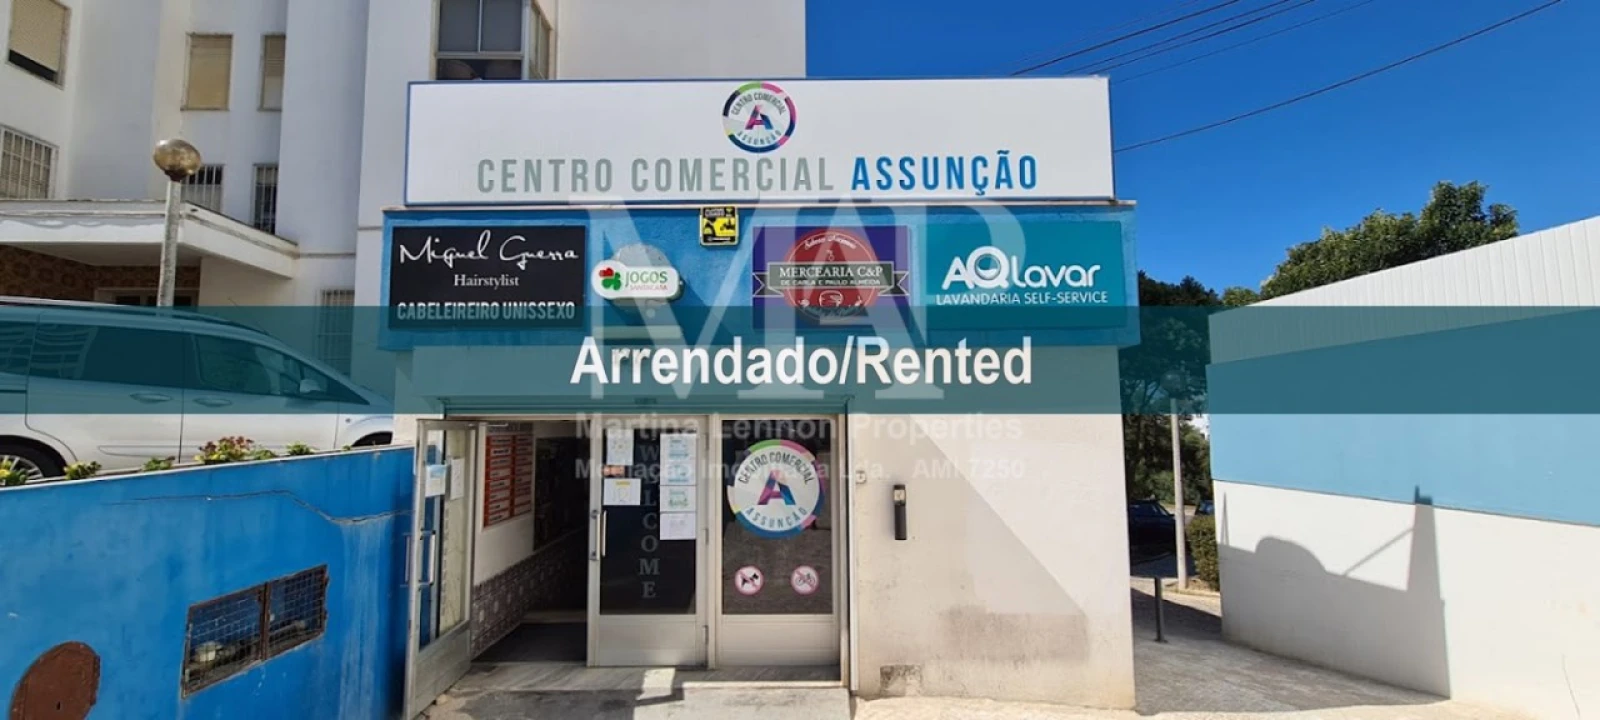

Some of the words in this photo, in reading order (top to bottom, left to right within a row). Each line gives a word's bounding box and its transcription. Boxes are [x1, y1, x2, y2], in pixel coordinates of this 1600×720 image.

[731, 94, 752, 115] CENTRO
[754, 92, 786, 115] COMERCIAL
[477, 158, 613, 193] CENTRO
[631, 157, 834, 191] COMERCIAL
[851, 149, 1037, 196] ASSUNÇÃO
[399, 229, 491, 270] Miguel
[499, 235, 579, 270] Guerra
[625, 271, 668, 288] JOGOS
[780, 266, 854, 278] MERCEARIA
[857, 265, 883, 277] C&P
[453, 273, 520, 290] Hairstylist
[936, 292, 1021, 306] LAVANDARIA
[1024, 290, 1108, 305] SELF-SERVICE
[397, 301, 500, 320] CABELEIREIRO
[502, 301, 576, 320] UNISSEXO
[738, 454, 768, 485] CENTRO
[769, 451, 815, 485] COMERCIAL
